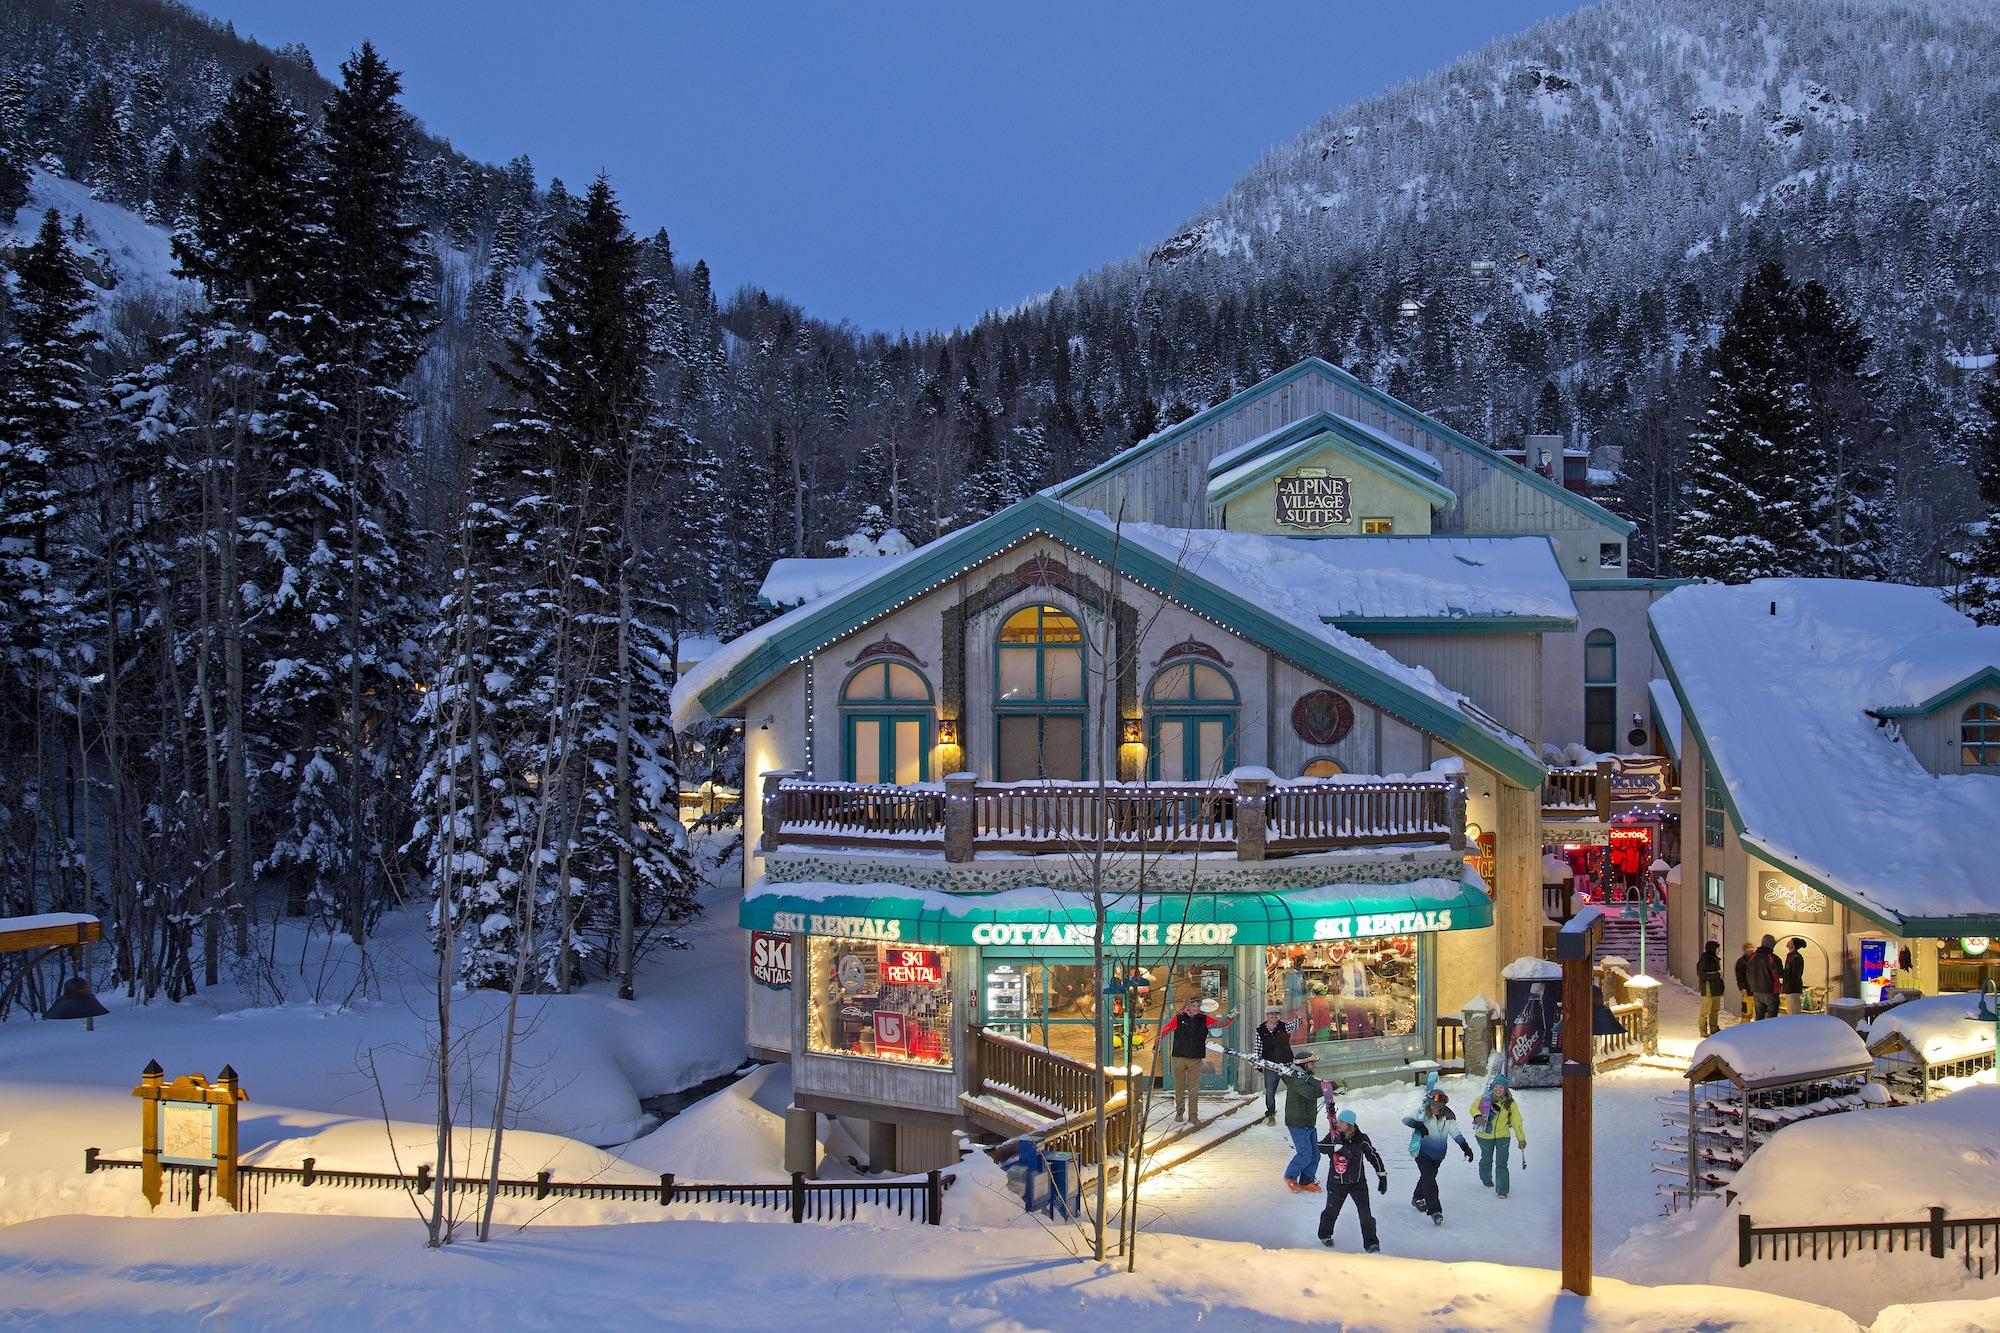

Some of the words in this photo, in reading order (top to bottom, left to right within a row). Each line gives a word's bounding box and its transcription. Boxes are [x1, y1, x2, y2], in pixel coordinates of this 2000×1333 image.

[1279, 479, 1344, 495] ALPINE
[1281, 495, 1345, 509] VILLAGE
[1285, 509, 1343, 523] SUITES
[1610, 775, 1661, 795] OCTORS
[1610, 830, 1649, 843] DOCTORS
[773, 912, 806, 933] SKI
[810, 915, 900, 940] RENTALS
[1313, 917, 1352, 941] SKI
[1356, 909, 1453, 936] RENTALS
[1111, 923, 1160, 945] SKI
[1166, 923, 1238, 945] SHOP
[754, 938, 792, 970] SKI
[901, 951, 924, 967] SKI
[1863, 960, 1884, 969] Red
[754, 966, 792, 984] RENTALS
[1512, 1031, 1539, 1062] Pepper
[1516, 1034, 1528, 1048] Dr
